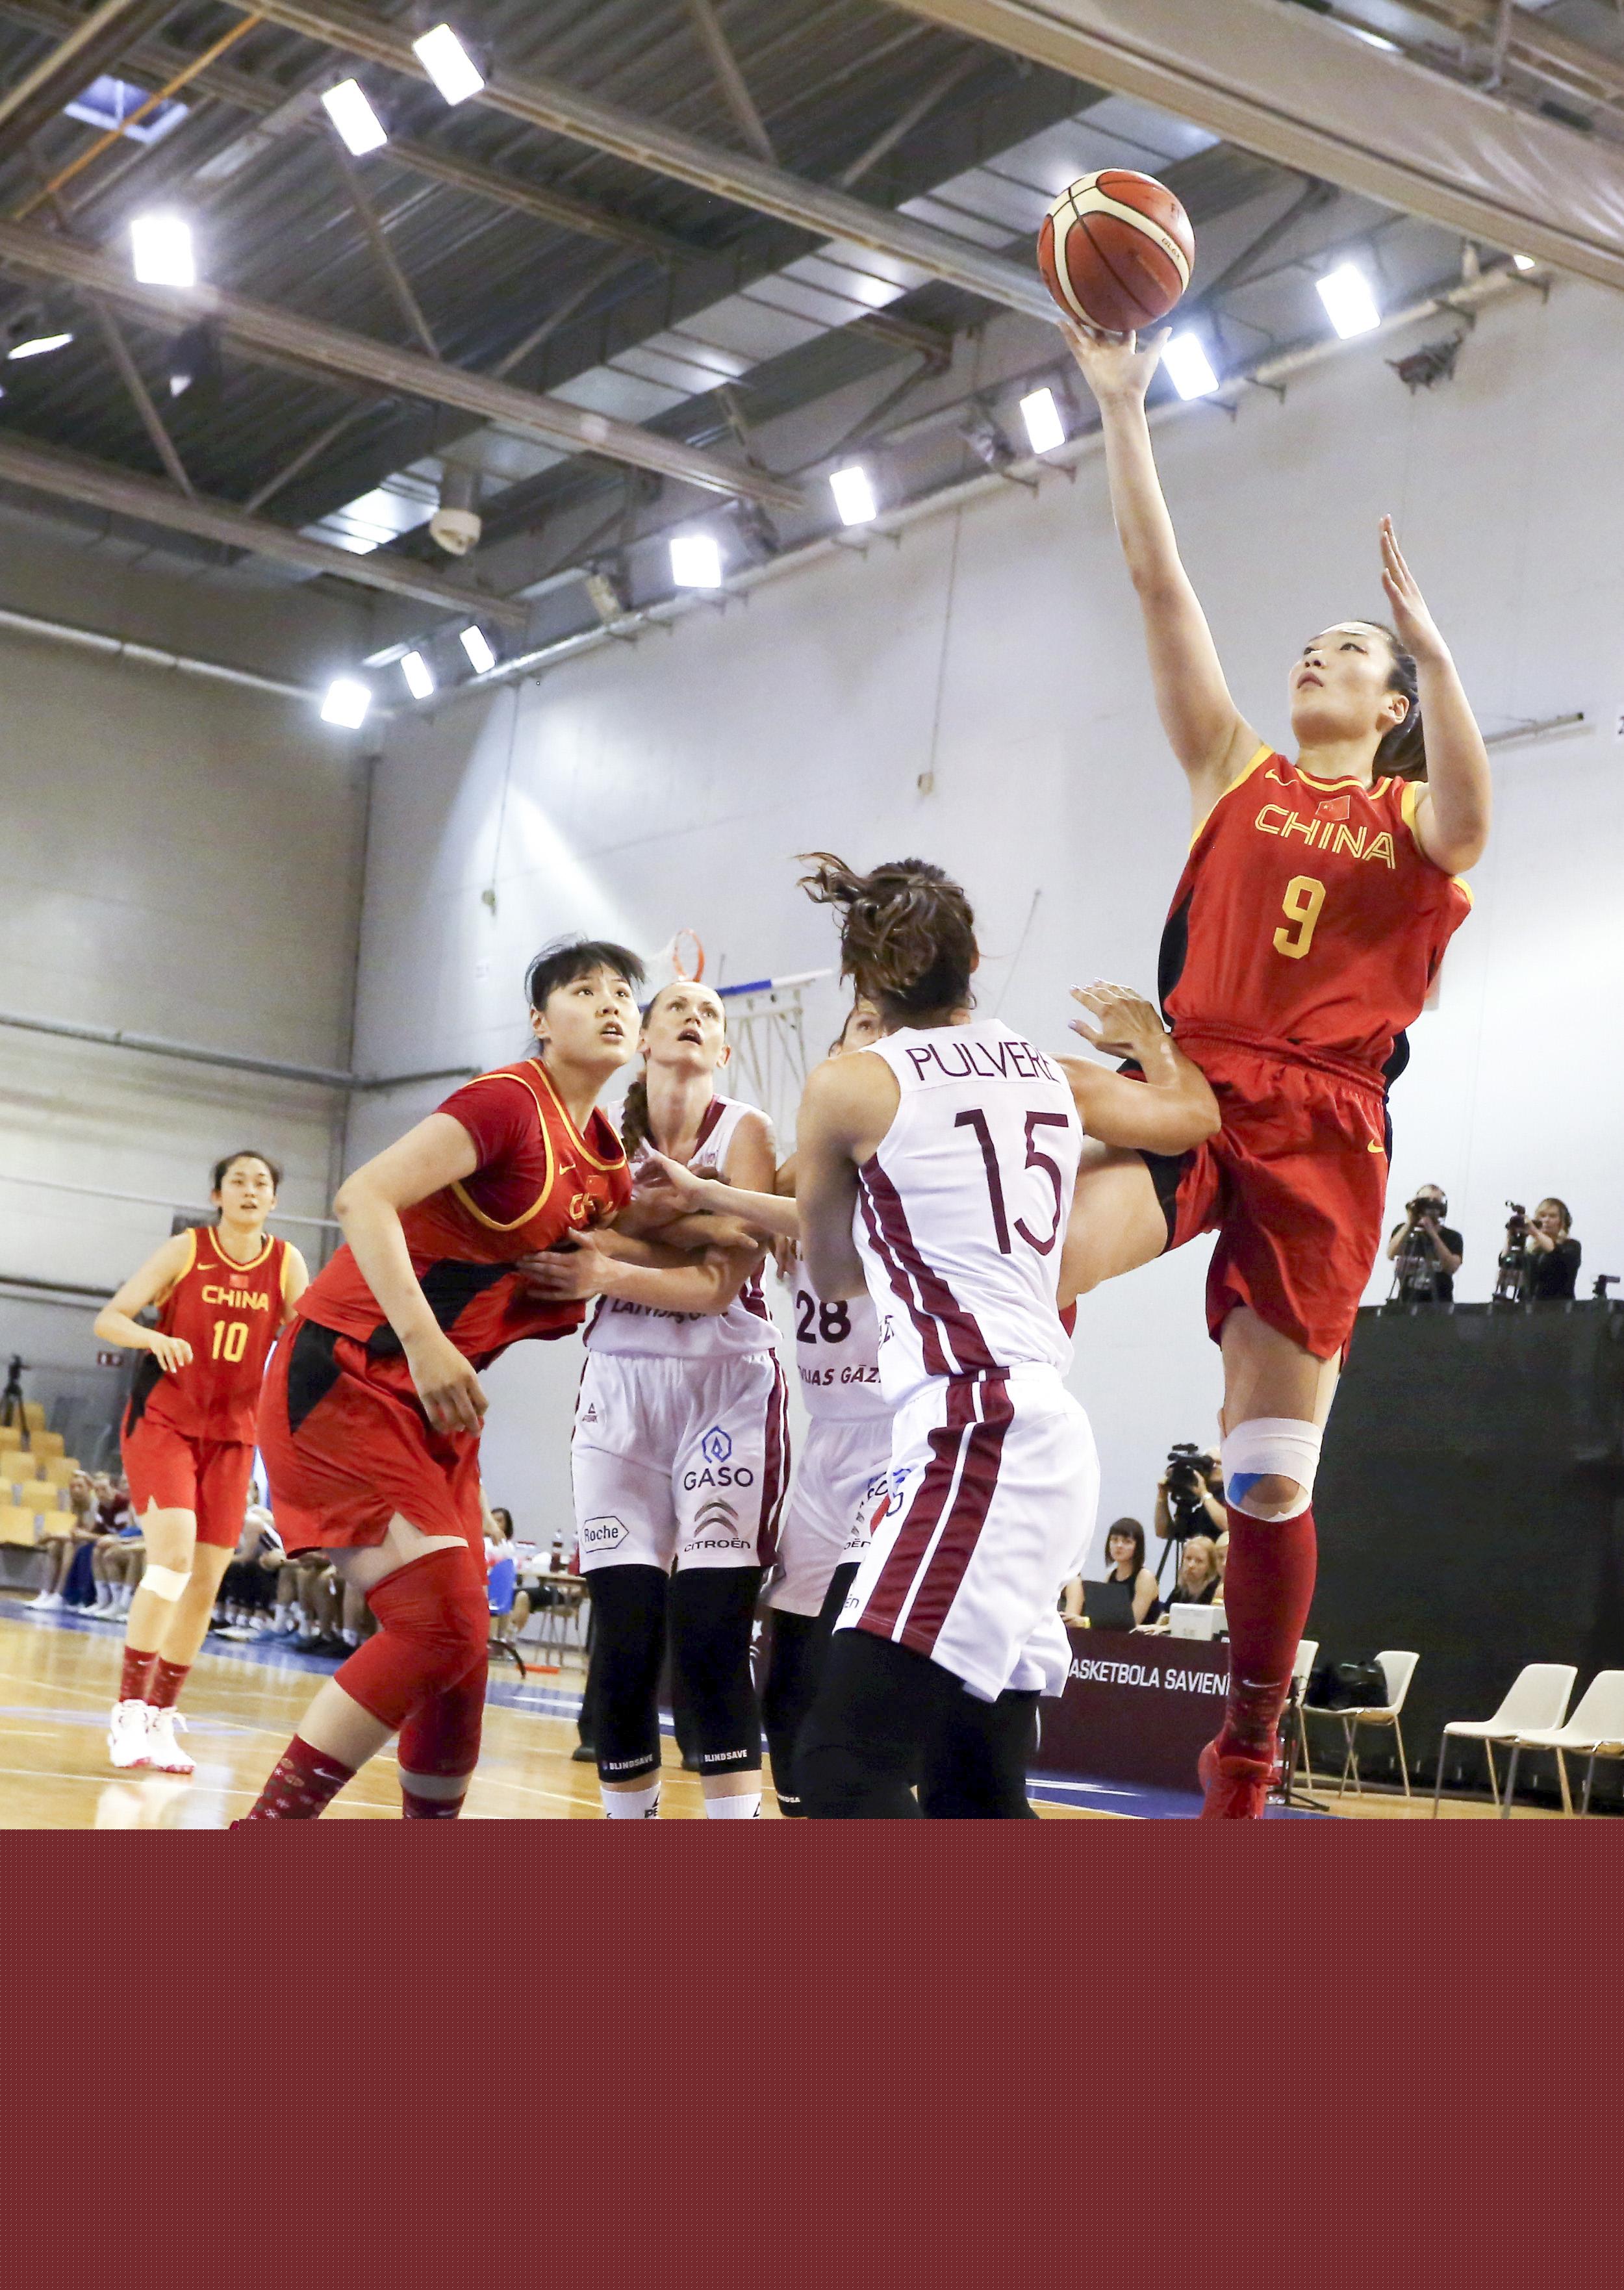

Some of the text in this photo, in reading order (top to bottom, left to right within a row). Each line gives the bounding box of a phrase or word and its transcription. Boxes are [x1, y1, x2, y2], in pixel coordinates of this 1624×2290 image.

[1254, 804, 1396, 869] CHINA
[1272, 874, 1326, 960] 9
[954, 1108, 1069, 1256] 15
[201, 1284, 269, 1312] CHINA
[796, 1290, 852, 1343] 28
[212, 1320, 249, 1363] 10
[841, 1364, 881, 1384] GĀZ
[684, 1466, 754, 1491] GASO
[584, 1525, 618, 1542] Roche
[609, 1754, 653, 1770] BLINDSAVE
[704, 1749, 748, 1762] BLINDSAVE
